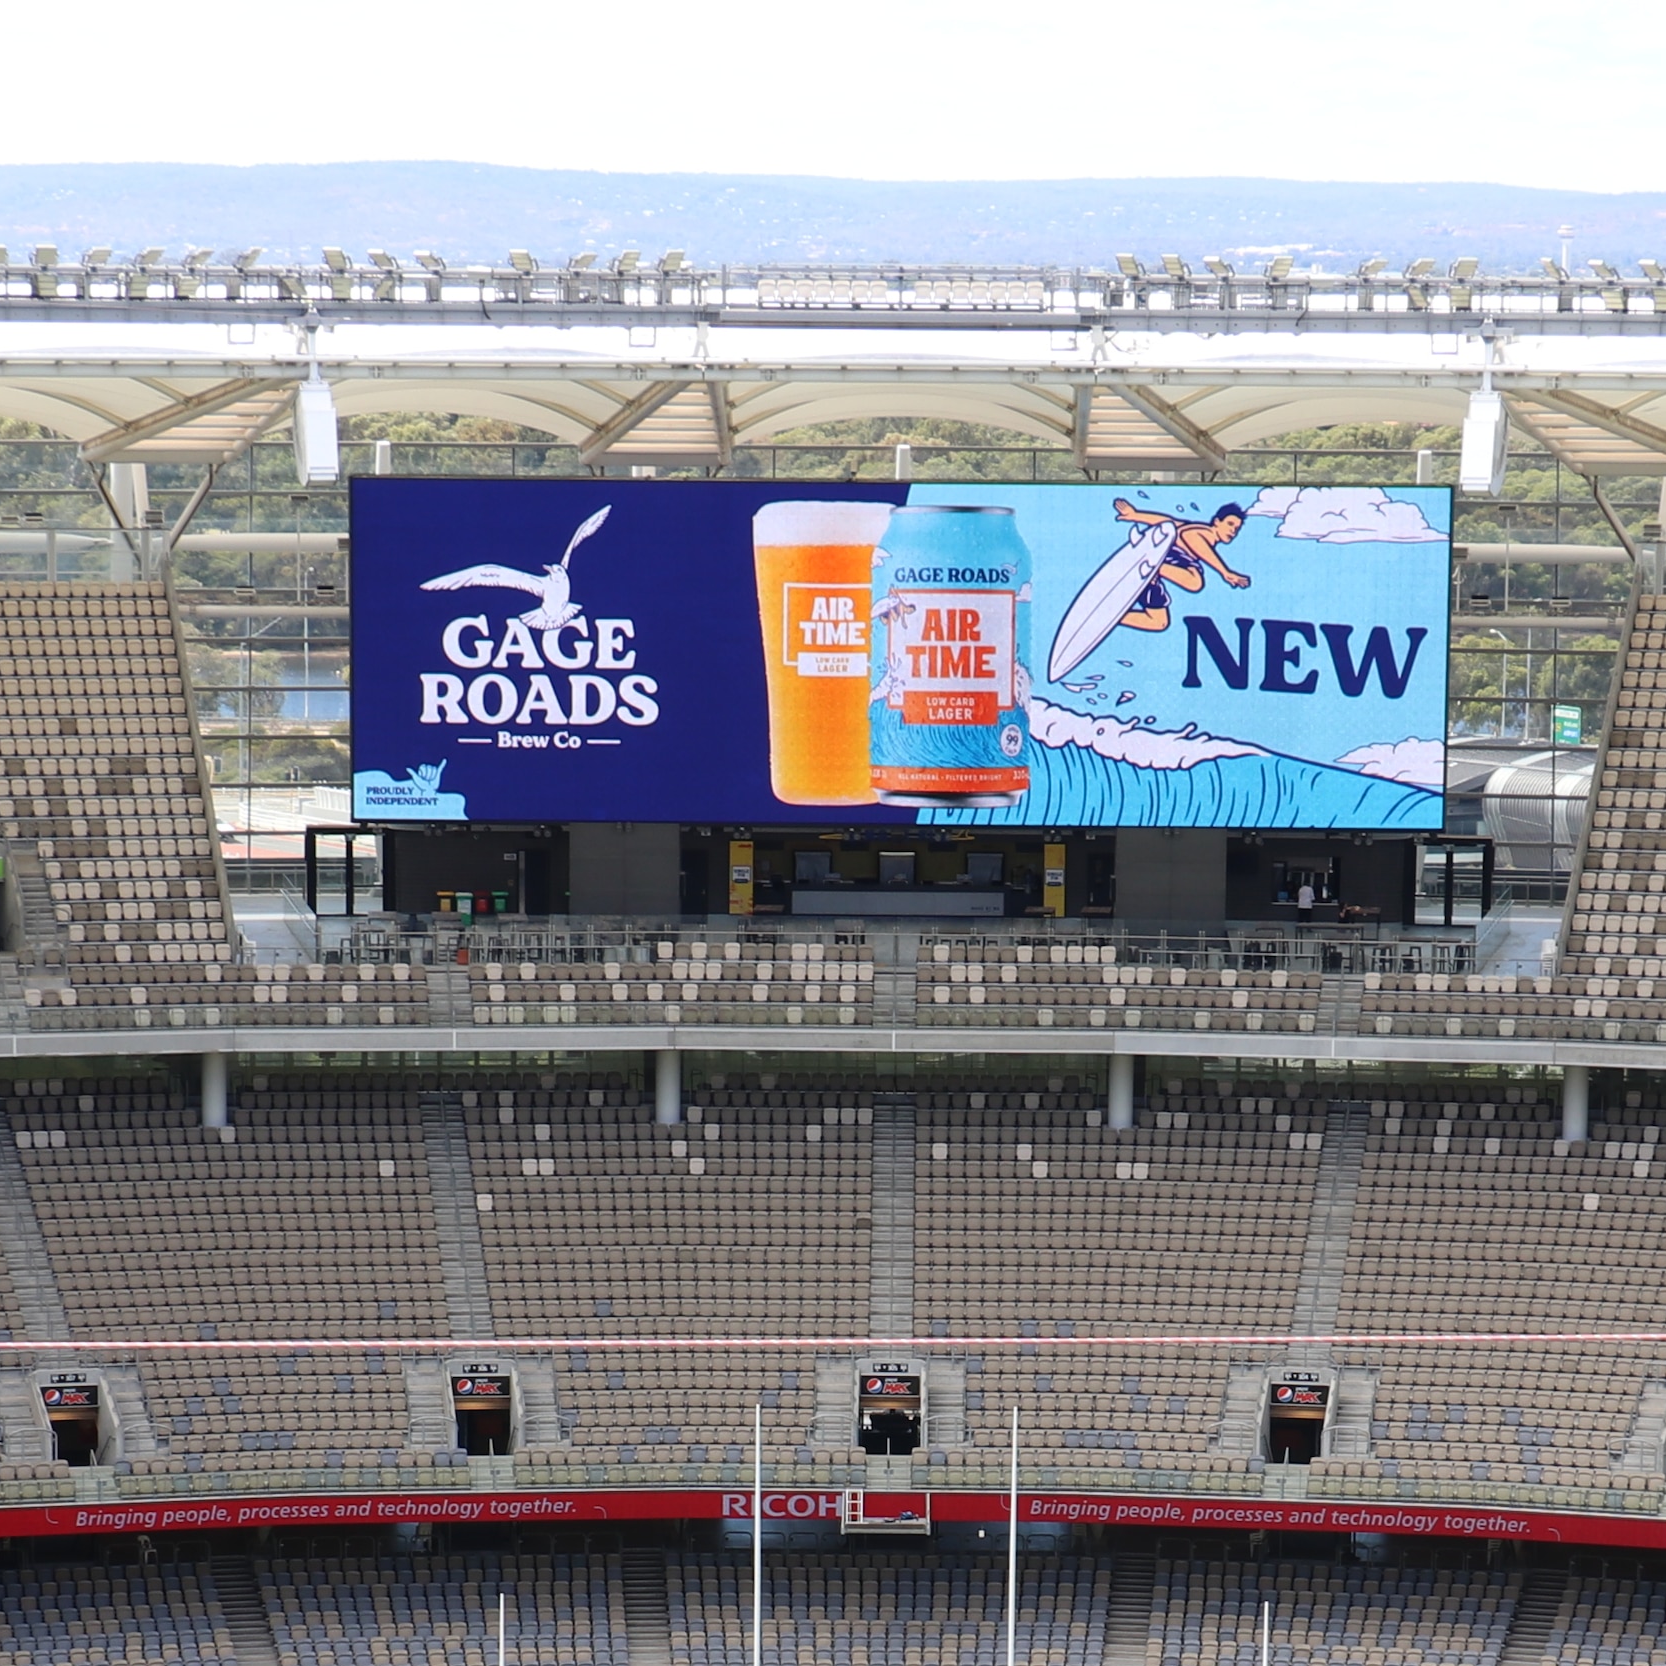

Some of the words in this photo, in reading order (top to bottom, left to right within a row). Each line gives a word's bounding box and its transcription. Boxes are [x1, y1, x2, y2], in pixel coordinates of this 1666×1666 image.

[894, 567, 944, 584] GAGE
[947, 567, 1011, 584] ROADS
[811, 596, 855, 620] AIR
[799, 622, 866, 646] TIME
[921, 608, 982, 642] AIR
[442, 614, 636, 669] GAGE
[817, 664, 848, 673] LAGER
[905, 645, 997, 679] TIME
[1182, 616, 1428, 699] NEW
[419, 673, 660, 726] ROADS
[926, 697, 947, 707] LOW
[949, 697, 975, 707] CARB
[928, 708, 974, 721] LAGER
[497, 731, 549, 748] Brew
[553, 731, 582, 749] Co
[1006, 733, 1019, 747] 99
[365, 796, 439, 806] INDEPENDENT
[366, 787, 414, 796] PROUDLY
[76, 1509, 157, 1528] Bringing
[163, 1506, 232, 1526] people,
[238, 1504, 329, 1523] processes
[335, 1502, 372, 1517] and
[378, 1499, 484, 1518] technology
[491, 1498, 577, 1516] together.
[1031, 1499, 1111, 1519] Bringing
[1116, 1503, 1186, 1523] people,
[1192, 1508, 1283, 1525] processes
[1289, 1510, 1326, 1526] and
[1332, 1512, 1439, 1532] technology
[1445, 1516, 1532, 1535] together.
